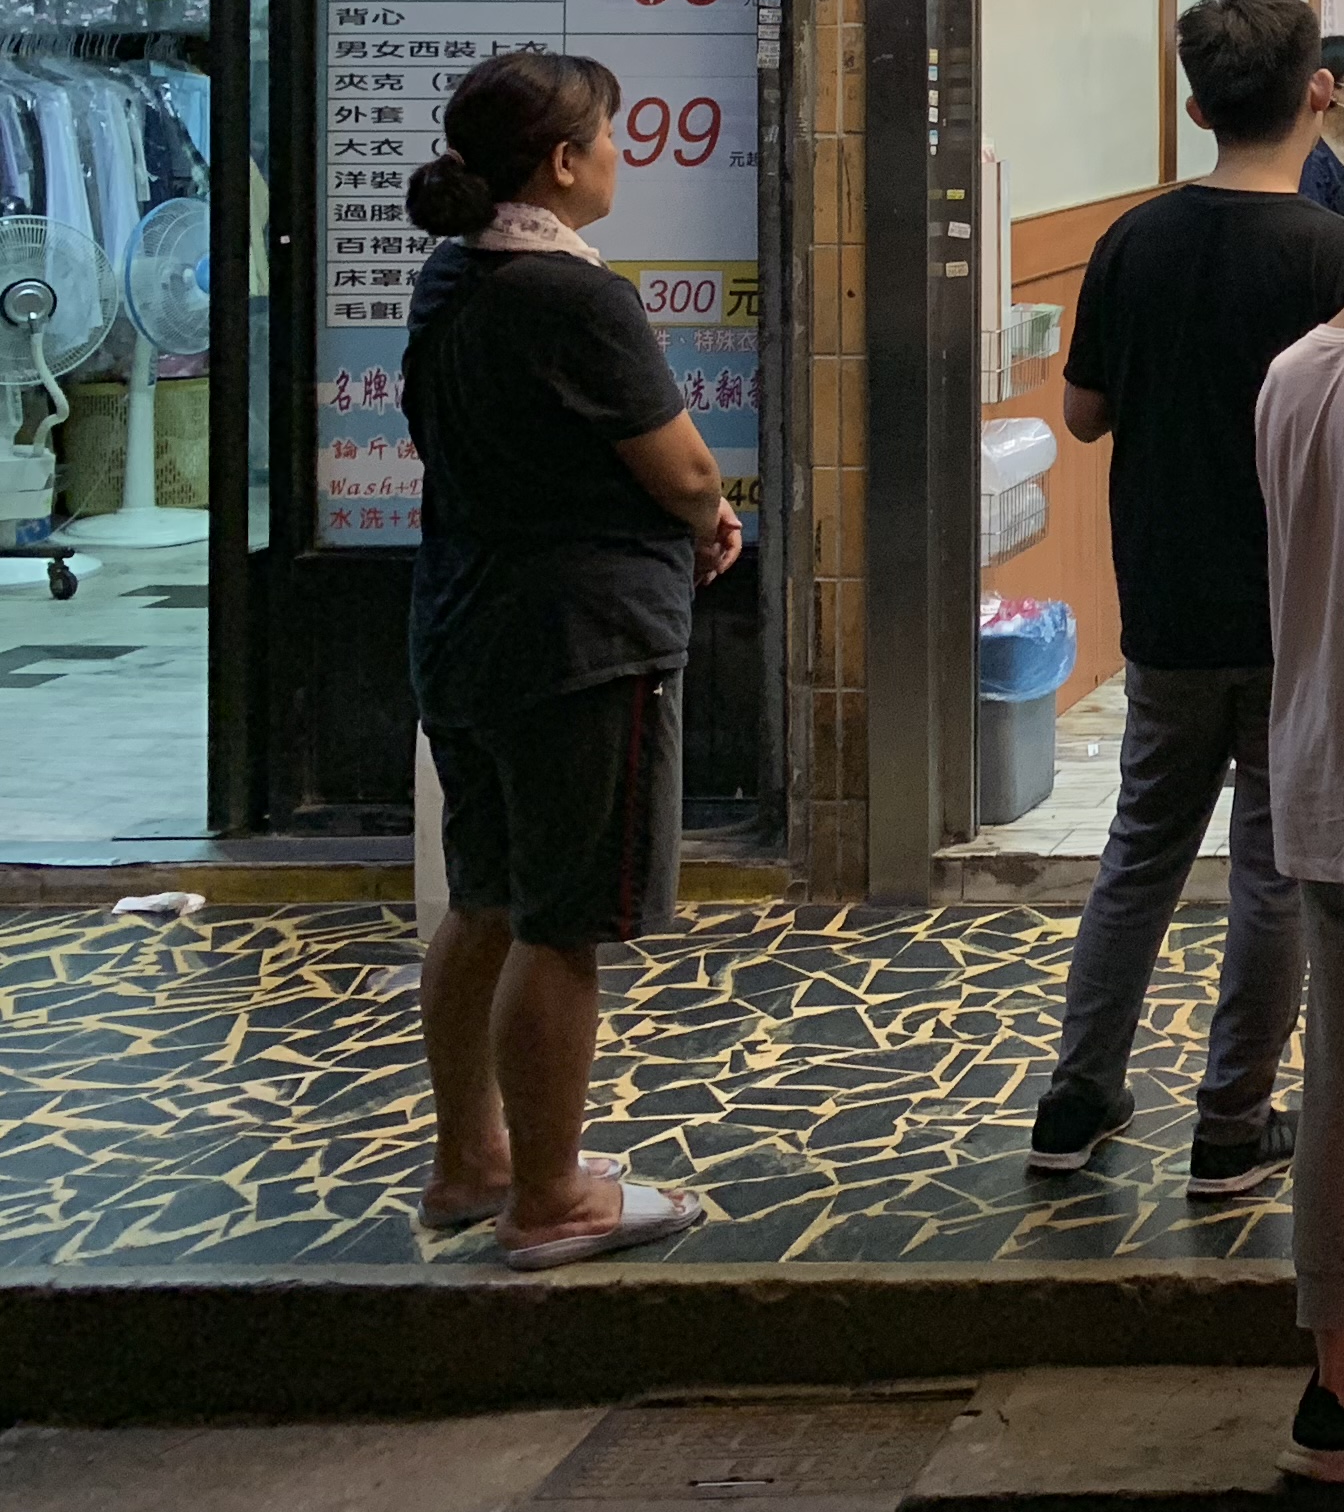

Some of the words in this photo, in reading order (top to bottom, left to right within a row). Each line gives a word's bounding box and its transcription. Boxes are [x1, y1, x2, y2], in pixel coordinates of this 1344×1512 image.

[336, 8, 406, 26] 背心
[623, 97, 722, 167] 99
[335, 171, 403, 189] 洋裝
[335, 237, 438, 254] 百褶裙
[646, 280, 716, 313] 300
[330, 370, 404, 411] 名牌
